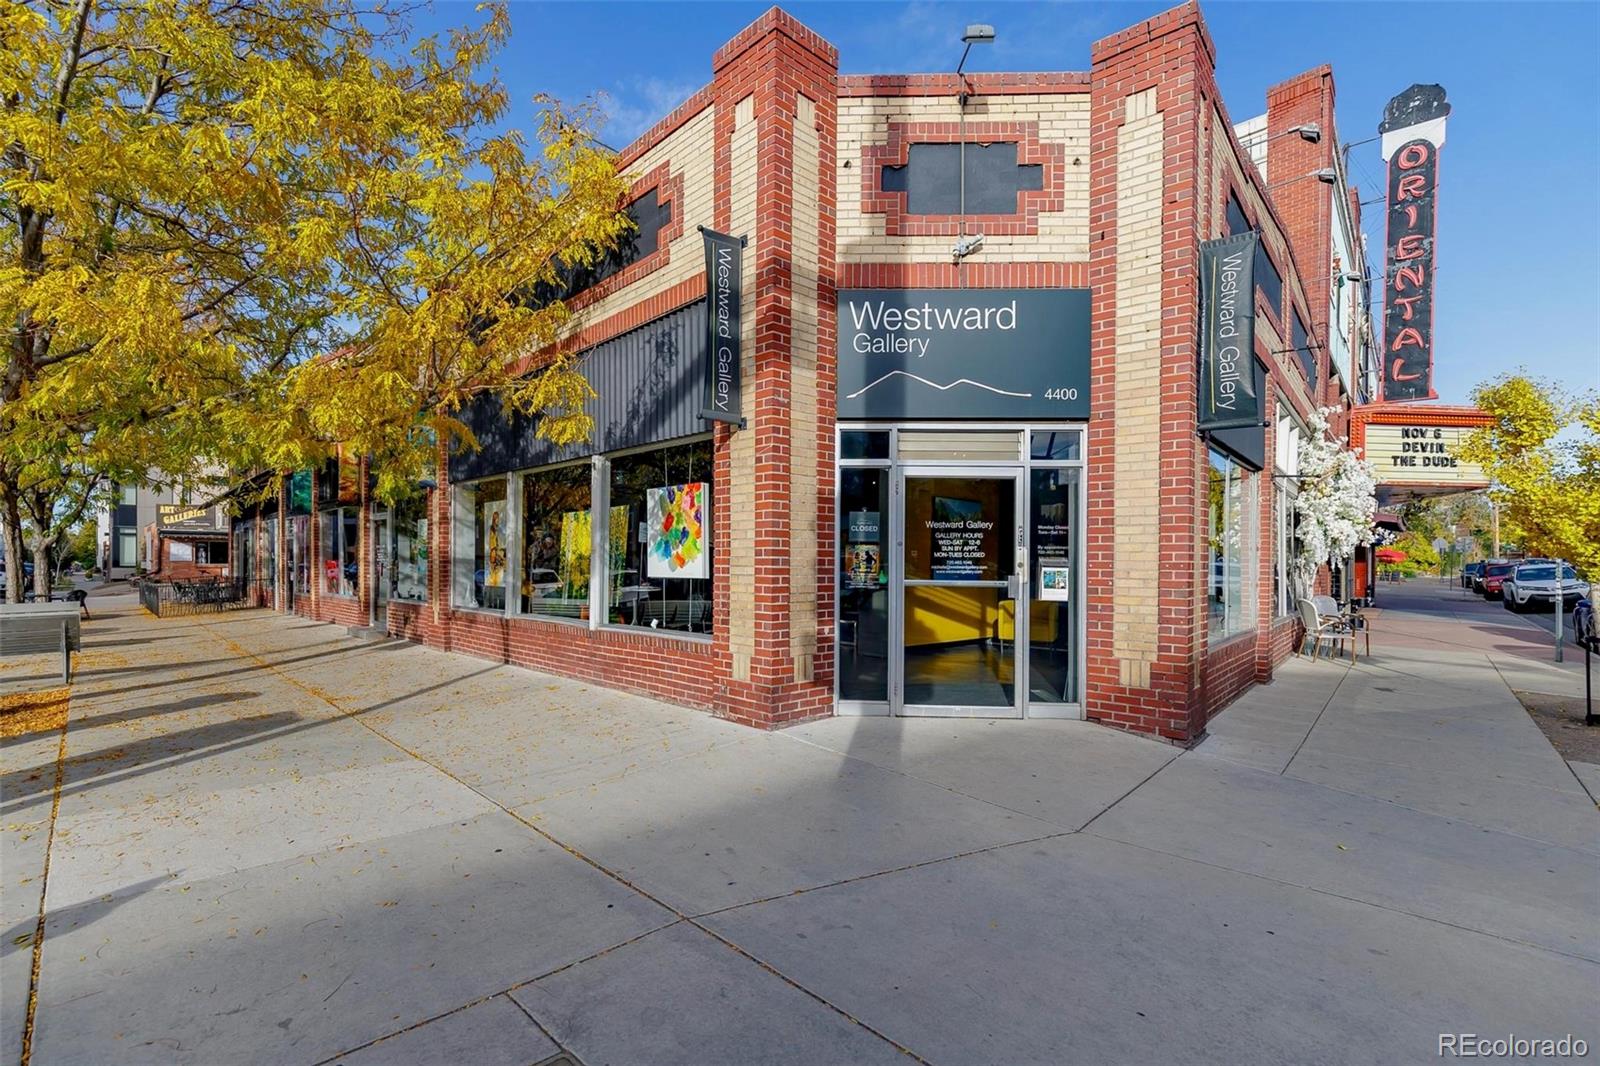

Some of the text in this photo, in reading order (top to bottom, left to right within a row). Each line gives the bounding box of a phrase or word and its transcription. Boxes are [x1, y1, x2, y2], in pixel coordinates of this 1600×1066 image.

[1391, 143, 1428, 383] ORIENTAL
[849, 300, 1017, 331] Westward
[715, 248, 732, 412] Westward Gallery
[1216, 251, 1242, 411] Westward Gallery
[852, 332, 930, 358] Gallery
[1044, 388, 1078, 401] 4400
[1401, 427, 1442, 439] NOV 6
[1402, 441, 1445, 453] DEVIN
[1391, 455, 1458, 468] THE DUDE
[925, 520, 994, 530] Westward Gallery
